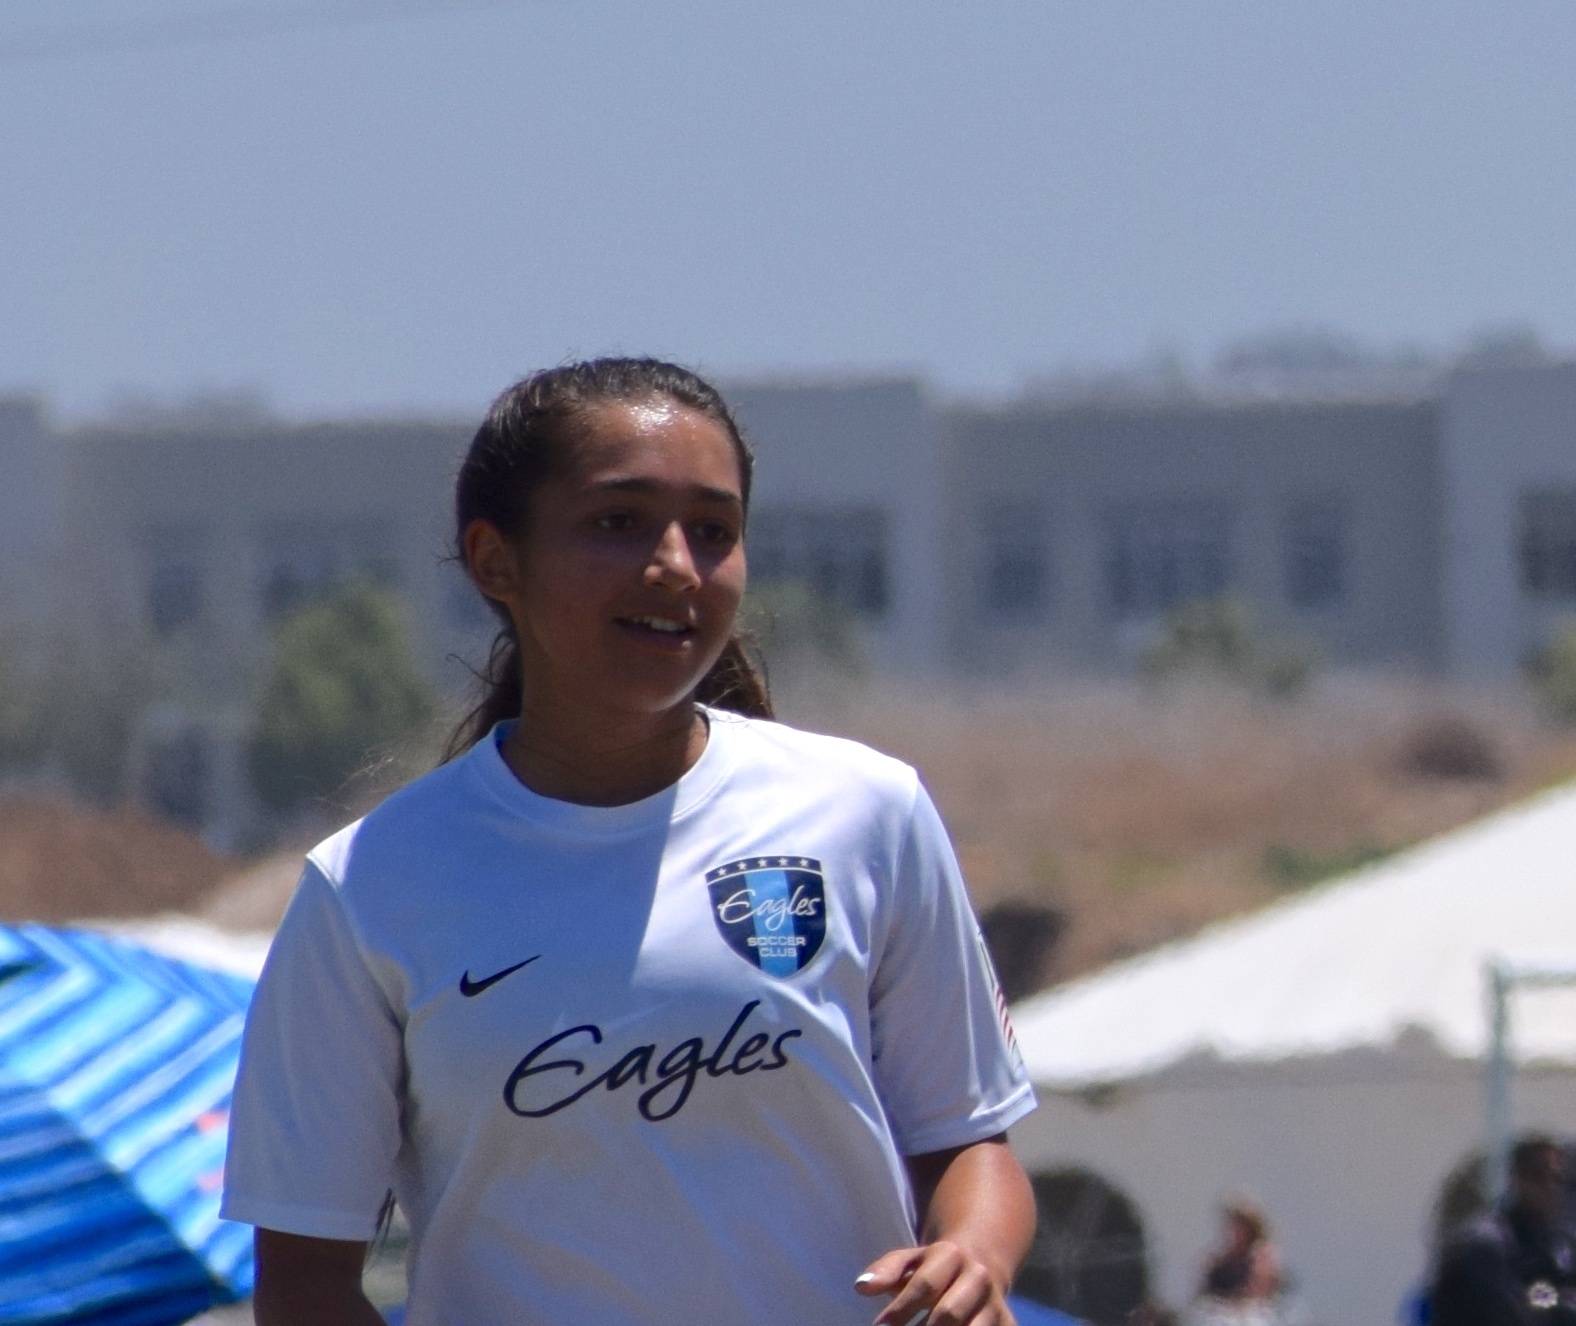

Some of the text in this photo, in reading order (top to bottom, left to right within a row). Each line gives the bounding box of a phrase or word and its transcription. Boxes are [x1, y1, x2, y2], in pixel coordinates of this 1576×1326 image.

[717, 884, 821, 931] Eagles
[747, 936, 806, 947] SOCCER
[760, 947, 798, 957] CLUB
[502, 1000, 803, 1122] Eagles
